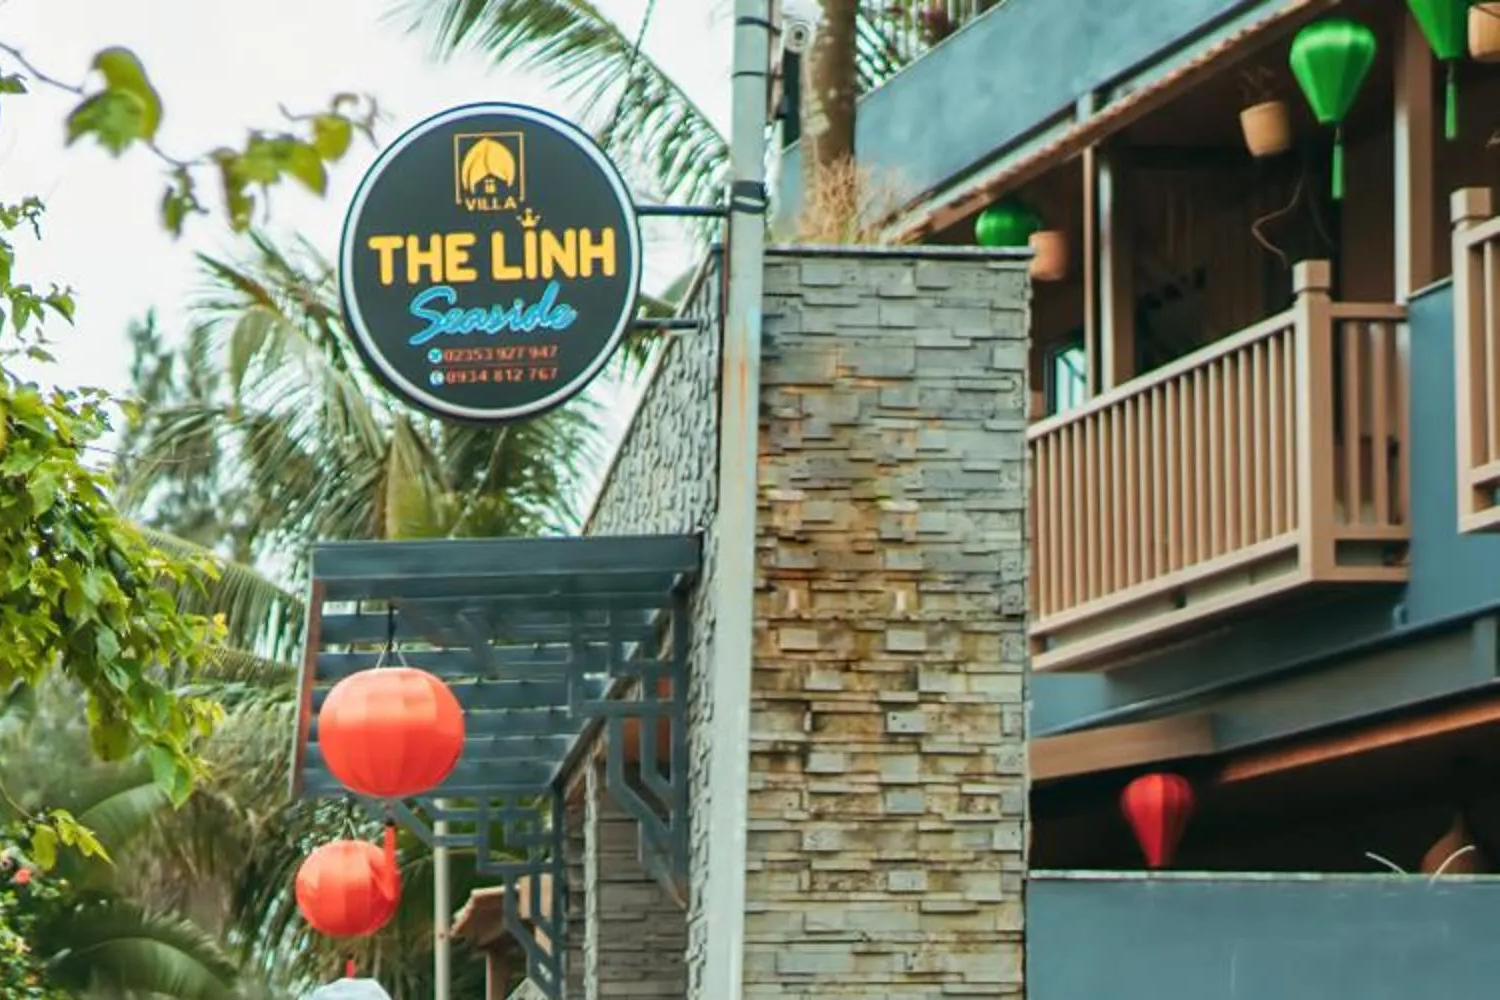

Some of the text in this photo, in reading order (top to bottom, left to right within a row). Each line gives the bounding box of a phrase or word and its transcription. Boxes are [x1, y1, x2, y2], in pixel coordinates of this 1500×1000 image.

[465, 197, 517, 211] VILLA
[368, 227, 616, 285] THE LINH
[408, 280, 579, 346] Seaside
[446, 368, 488, 384] 0934
